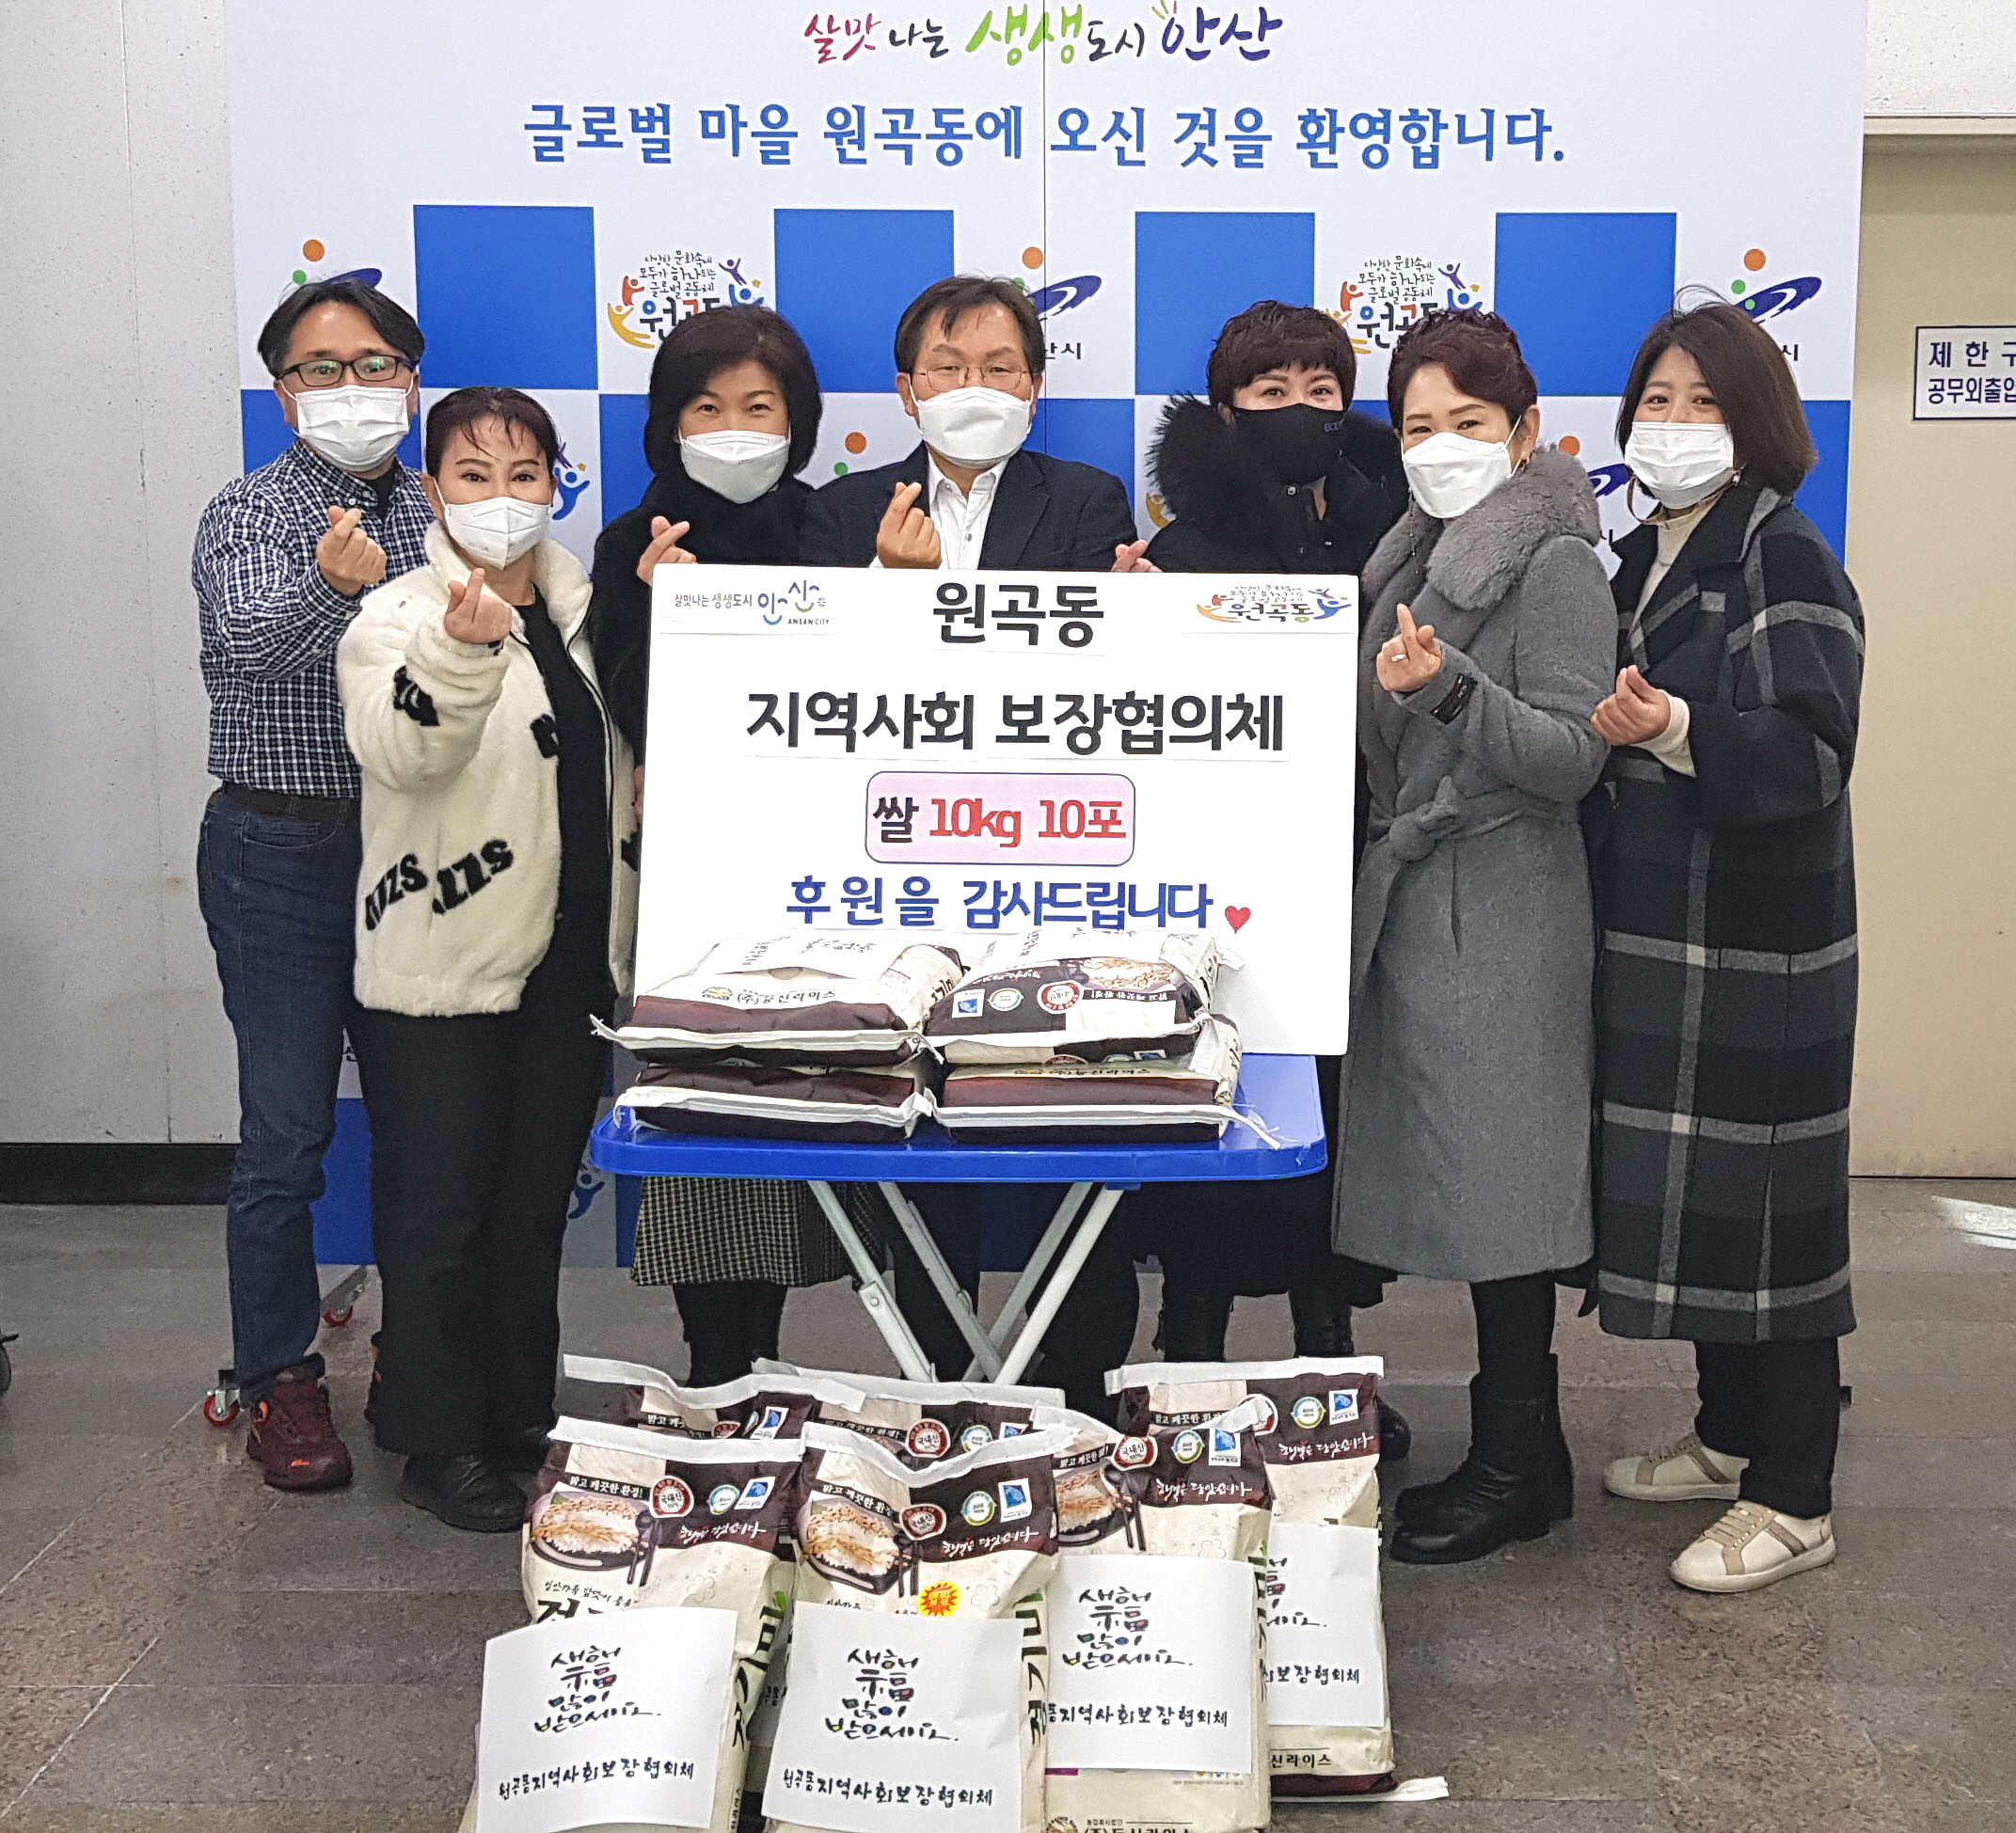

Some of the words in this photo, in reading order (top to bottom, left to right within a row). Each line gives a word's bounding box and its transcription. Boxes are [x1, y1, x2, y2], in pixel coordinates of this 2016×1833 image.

[524, 103, 675, 164] 글로벌
[699, 103, 800, 166] 마을
[822, 103, 1025, 166] 원곡동에
[1050, 105, 1149, 167] 오신
[1173, 105, 1273, 168] 것을
[1294, 104, 1565, 169] 환영합니다.
[932, 581, 1105, 649] 원곡동
[1228, 602, 1315, 624] 원곡동
[746, 691, 974, 752] 지역사회
[994, 689, 1284, 755] 보장협의체
[872, 796, 920, 844] 쌀
[929, 797, 1023, 848] 10kg
[1039, 798, 1127, 840] 10포
[961, 878, 1214, 931] 감사드립니다
[1078, 1586, 1152, 1604] 새해
[1076, 1633, 1142, 1650] 많이
[549, 1644, 622, 1668] 새해
[847, 1649, 920, 1670] 새해
[548, 1690, 611, 1712] 많이
[841, 1698, 907, 1719] 많이
